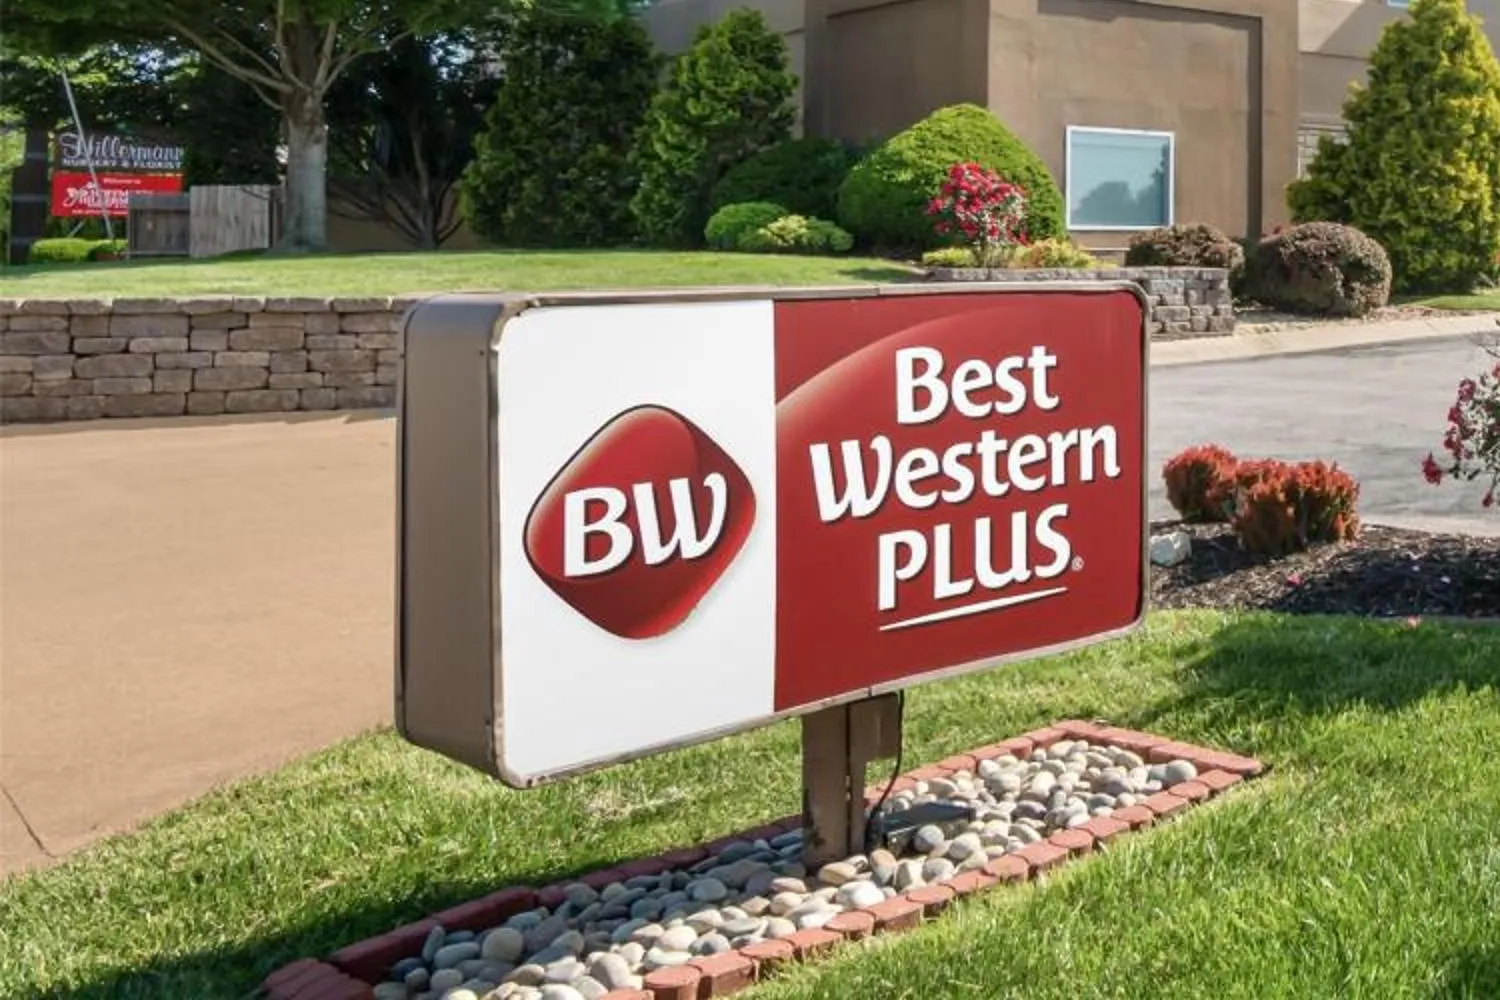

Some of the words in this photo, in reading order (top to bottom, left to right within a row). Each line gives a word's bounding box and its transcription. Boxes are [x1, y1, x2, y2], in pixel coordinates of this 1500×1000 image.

[63, 159, 117, 167] NURERY
[897, 346, 1058, 423] Best
[810, 425, 1120, 521] Western
[563, 473, 727, 577] BW
[879, 504, 1071, 610] PLUS
